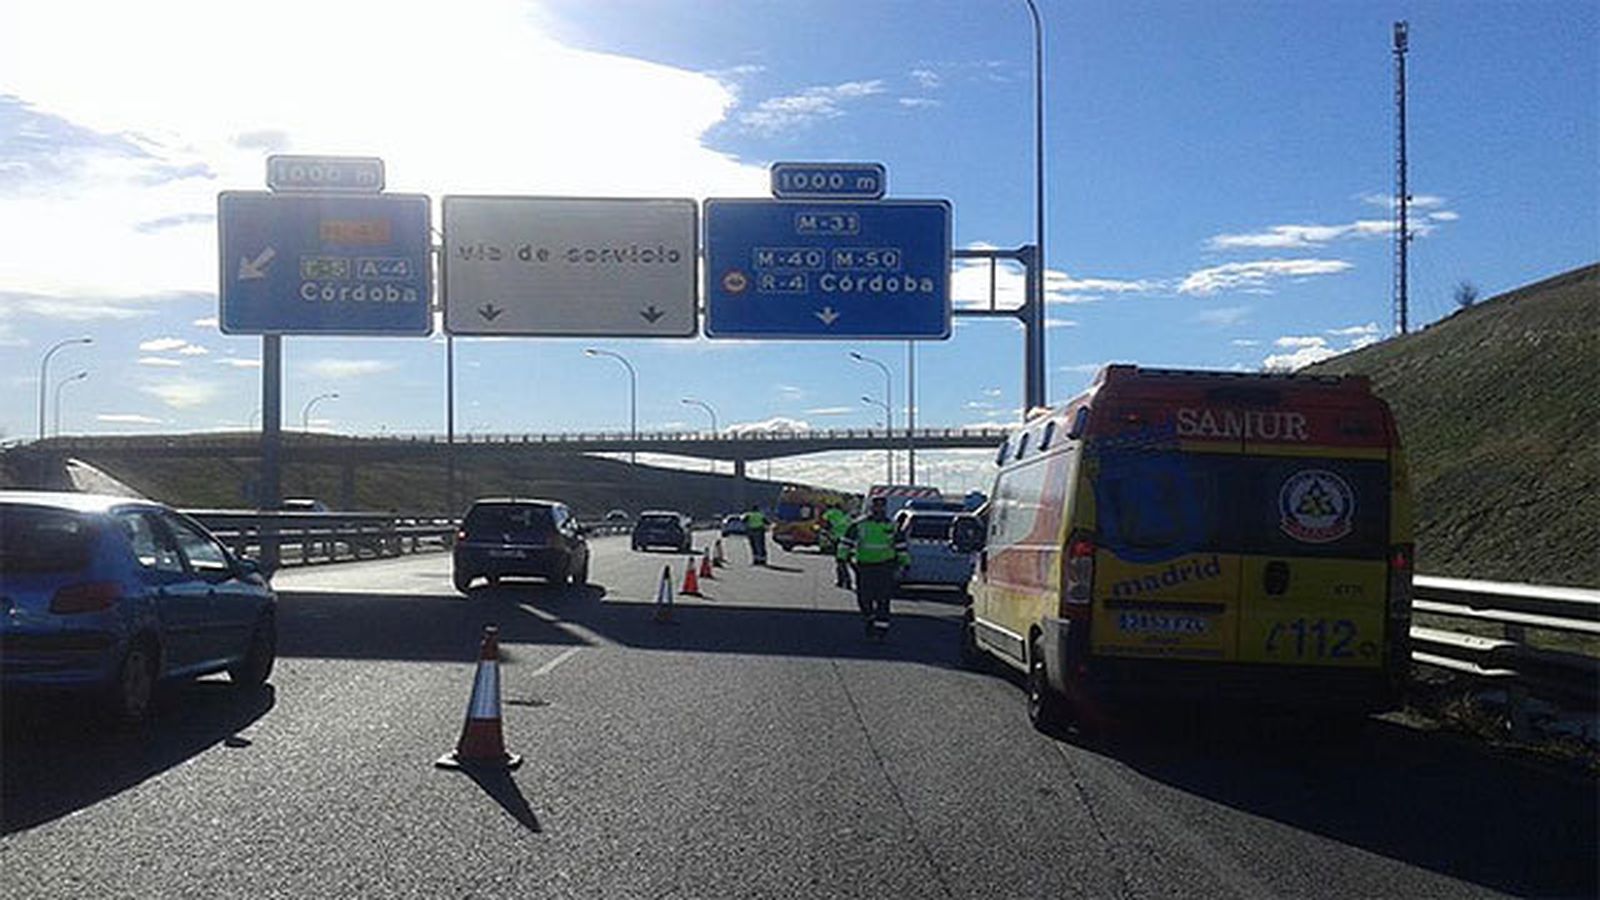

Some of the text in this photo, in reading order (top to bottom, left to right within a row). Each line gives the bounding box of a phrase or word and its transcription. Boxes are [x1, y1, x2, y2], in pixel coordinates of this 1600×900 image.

[781, 173, 875, 189] 1000 m
[758, 252, 896, 267] M-40 M-50
[301, 282, 416, 301] Córdoba
[820, 274, 933, 292] Córdoba
[1176, 408, 1309, 441] SAMUR
[1112, 556, 1221, 597] madrid
[1291, 617, 1357, 658] 112
